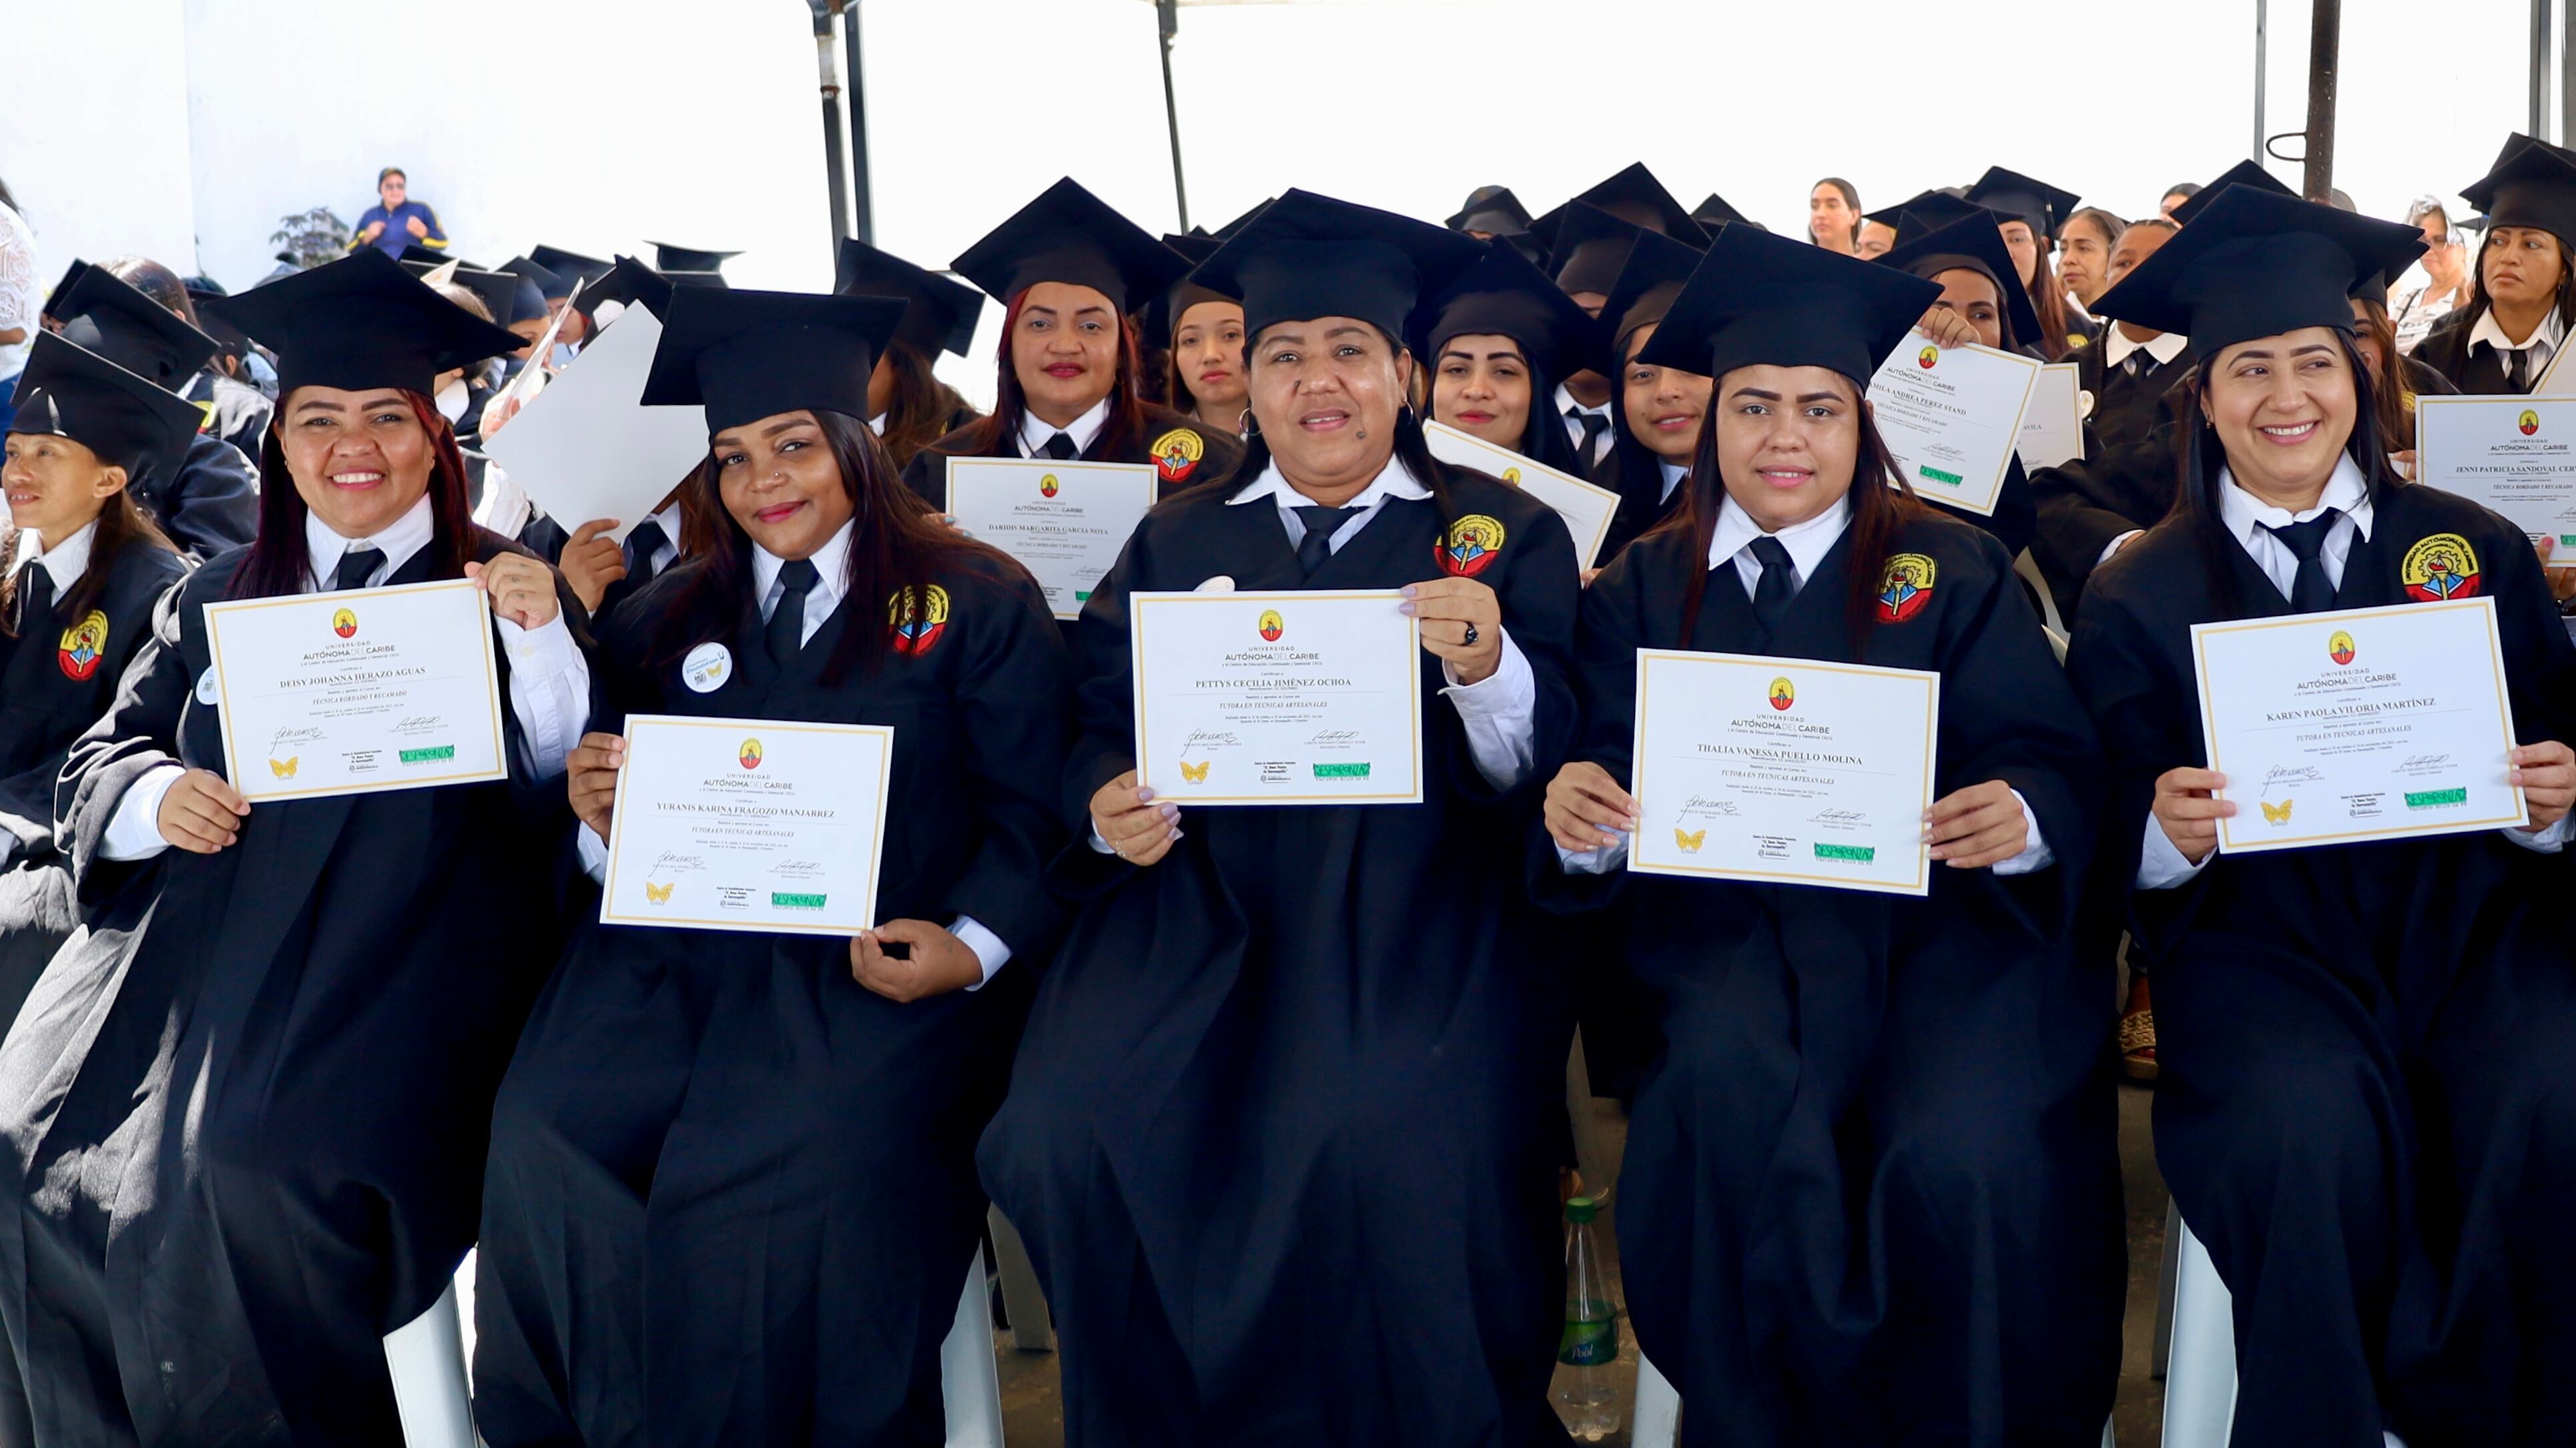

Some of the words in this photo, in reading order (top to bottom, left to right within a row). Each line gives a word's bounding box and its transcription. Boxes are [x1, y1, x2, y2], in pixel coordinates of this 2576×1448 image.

[325, 641, 370, 649] UNIVERSIDAD
[302, 648, 350, 660] AUTÓNOMA
[366, 645, 396, 654] CARIBE
[1225, 652, 1273, 660] AUTÓNOMA
[280, 679, 307, 687] DEISY
[309, 674, 353, 685] JOHANNA
[354, 671, 393, 681] HERAZO
[394, 667, 426, 677] AGUAS
[2320, 668, 2369, 677] UNIVERSIDAD
[1273, 677, 1315, 687] JIMÉNEZ
[2296, 676, 2348, 689] AUTÓNOMA
[2364, 673, 2396, 683] CARIBE
[2266, 711, 2301, 721] KAREN
[2303, 707, 2337, 717] PAOLA
[2338, 703, 2381, 714] VILORIA
[2382, 696, 2436, 710] MARTÍNEZ
[1756, 713, 1805, 722] UNIVERSIDAD
[1730, 717, 1782, 729] AUTÓNOMA
[1798, 725, 1830, 733] CARIBE
[1697, 744, 1734, 754] THALIA
[1736, 747, 1779, 757] VANESSA
[1781, 751, 1820, 761] PUELLO
[1822, 753, 1863, 764] MOLINA
[703, 778, 749, 787] AUTÓNOMA
[656, 803, 696, 811] YURANIS
[697, 804, 732, 813] KARINA
[734, 806, 778, 815] FRAGOZO
[779, 808, 835, 817] MANJARREZ
